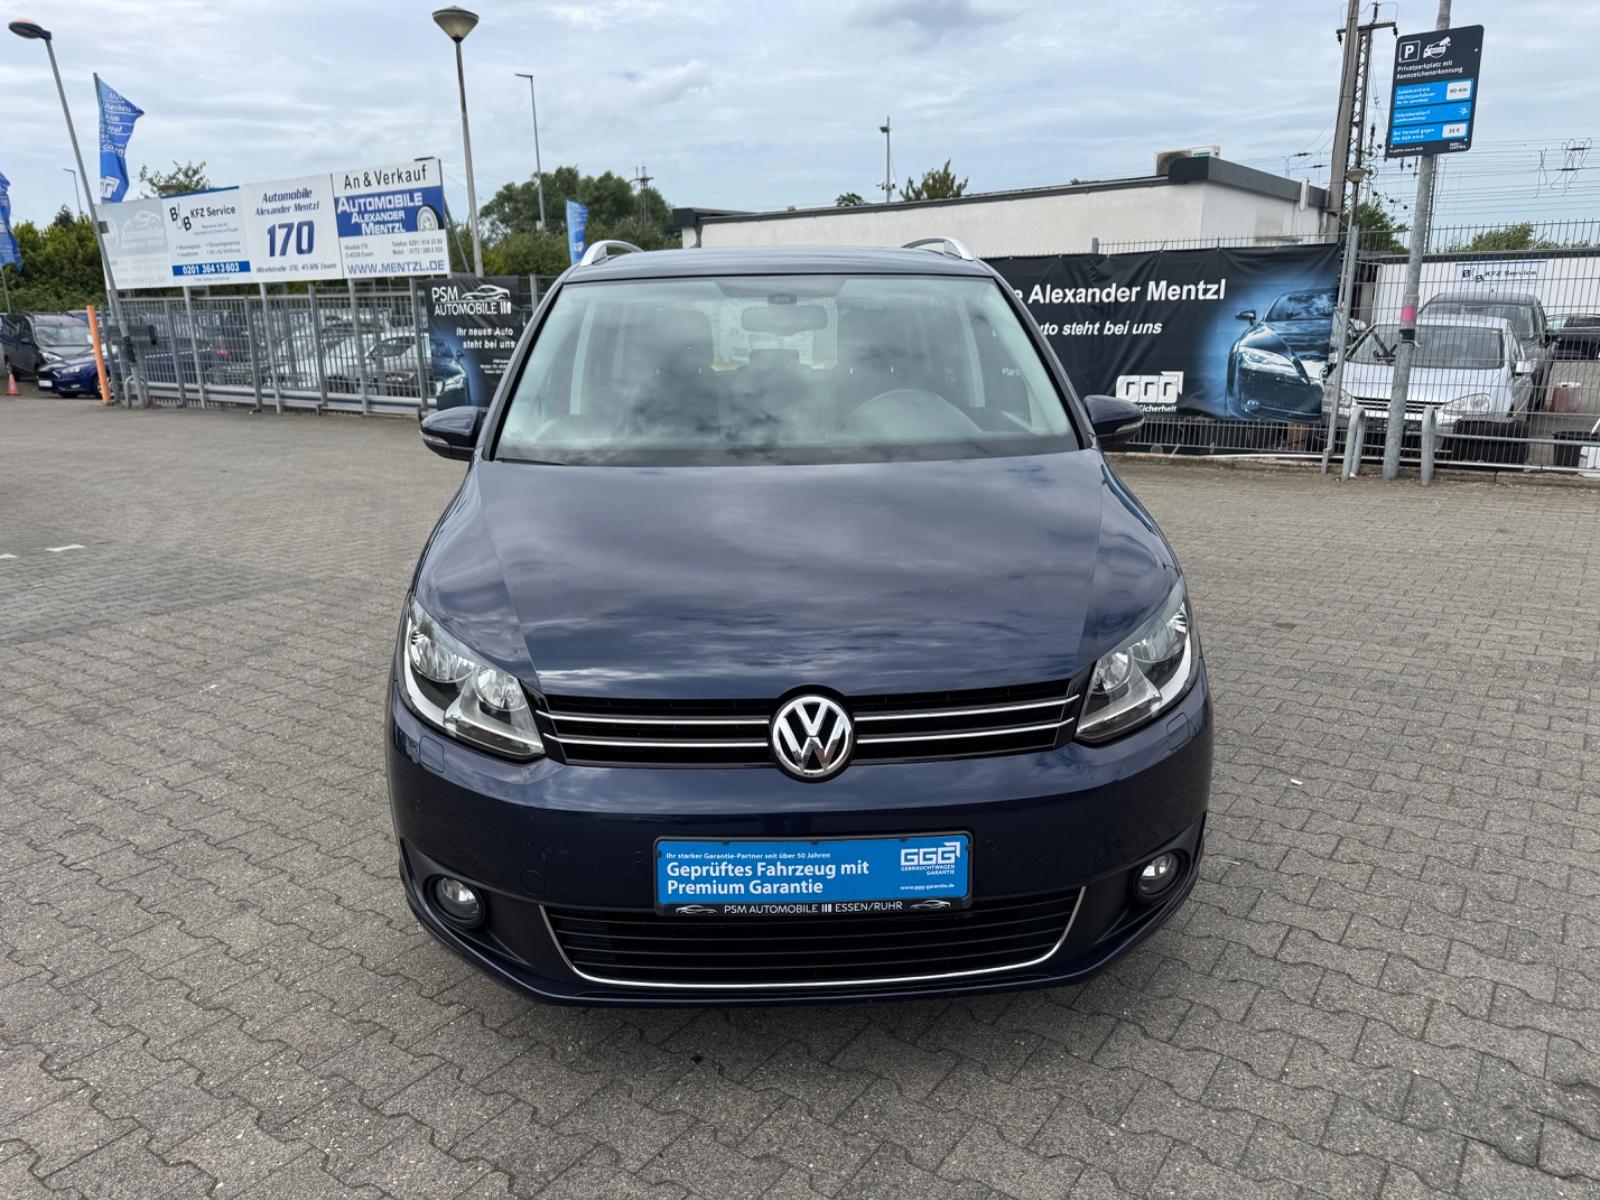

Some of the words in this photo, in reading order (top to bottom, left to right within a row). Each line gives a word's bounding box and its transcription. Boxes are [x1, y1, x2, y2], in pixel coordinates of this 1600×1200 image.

[1396, 67, 1464, 79] Kennzeichenerkennung
[1397, 62, 1442, 72] Privatparkplatz
[344, 174, 360, 190] An
[363, 172, 372, 188] &
[374, 164, 427, 186] Verkauf
[262, 188, 312, 203] Automobile
[255, 205, 291, 216] Alexander
[294, 201, 319, 212] Mentzl
[337, 192, 423, 214] AUTOMOBILE
[190, 208, 206, 218] KFZ
[206, 205, 236, 216] Service
[351, 210, 406, 224] ALEXANDER
[362, 222, 406, 236] MENTZL
[267, 220, 315, 257] 170
[182, 265, 199, 274] 0201
[347, 260, 445, 275] WWW.MENTZL.DE
[432, 286, 458, 302] PSM
[1028, 283, 1140, 304] Alexander
[1146, 279, 1226, 300] Mentzl
[435, 302, 497, 316] AUTOMOBILE
[456, 327, 467, 336] Ihr
[468, 328, 492, 336] neues
[494, 327, 513, 336] Auto
[1062, 322, 1100, 336] steht
[1103, 320, 1130, 335] bei
[1133, 322, 1162, 334] uns
[463, 340, 482, 349] steht
[484, 340, 496, 348] bei
[901, 842, 959, 866] GGG
[666, 862, 752, 880] Geprüftes
[757, 860, 836, 879] Fahrzeug
[841, 860, 869, 875] mit
[901, 864, 955, 872] GEBRAUCHTWAGEN
[667, 880, 745, 895] Premium
[749, 879, 823, 894] Garantie
[900, 883, 955, 891] www.ggg-garantie.de
[724, 904, 746, 914] PSM
[749, 903, 818, 913] AUTOMOBILE
[835, 902, 902, 912] ESSEN/RUHR
